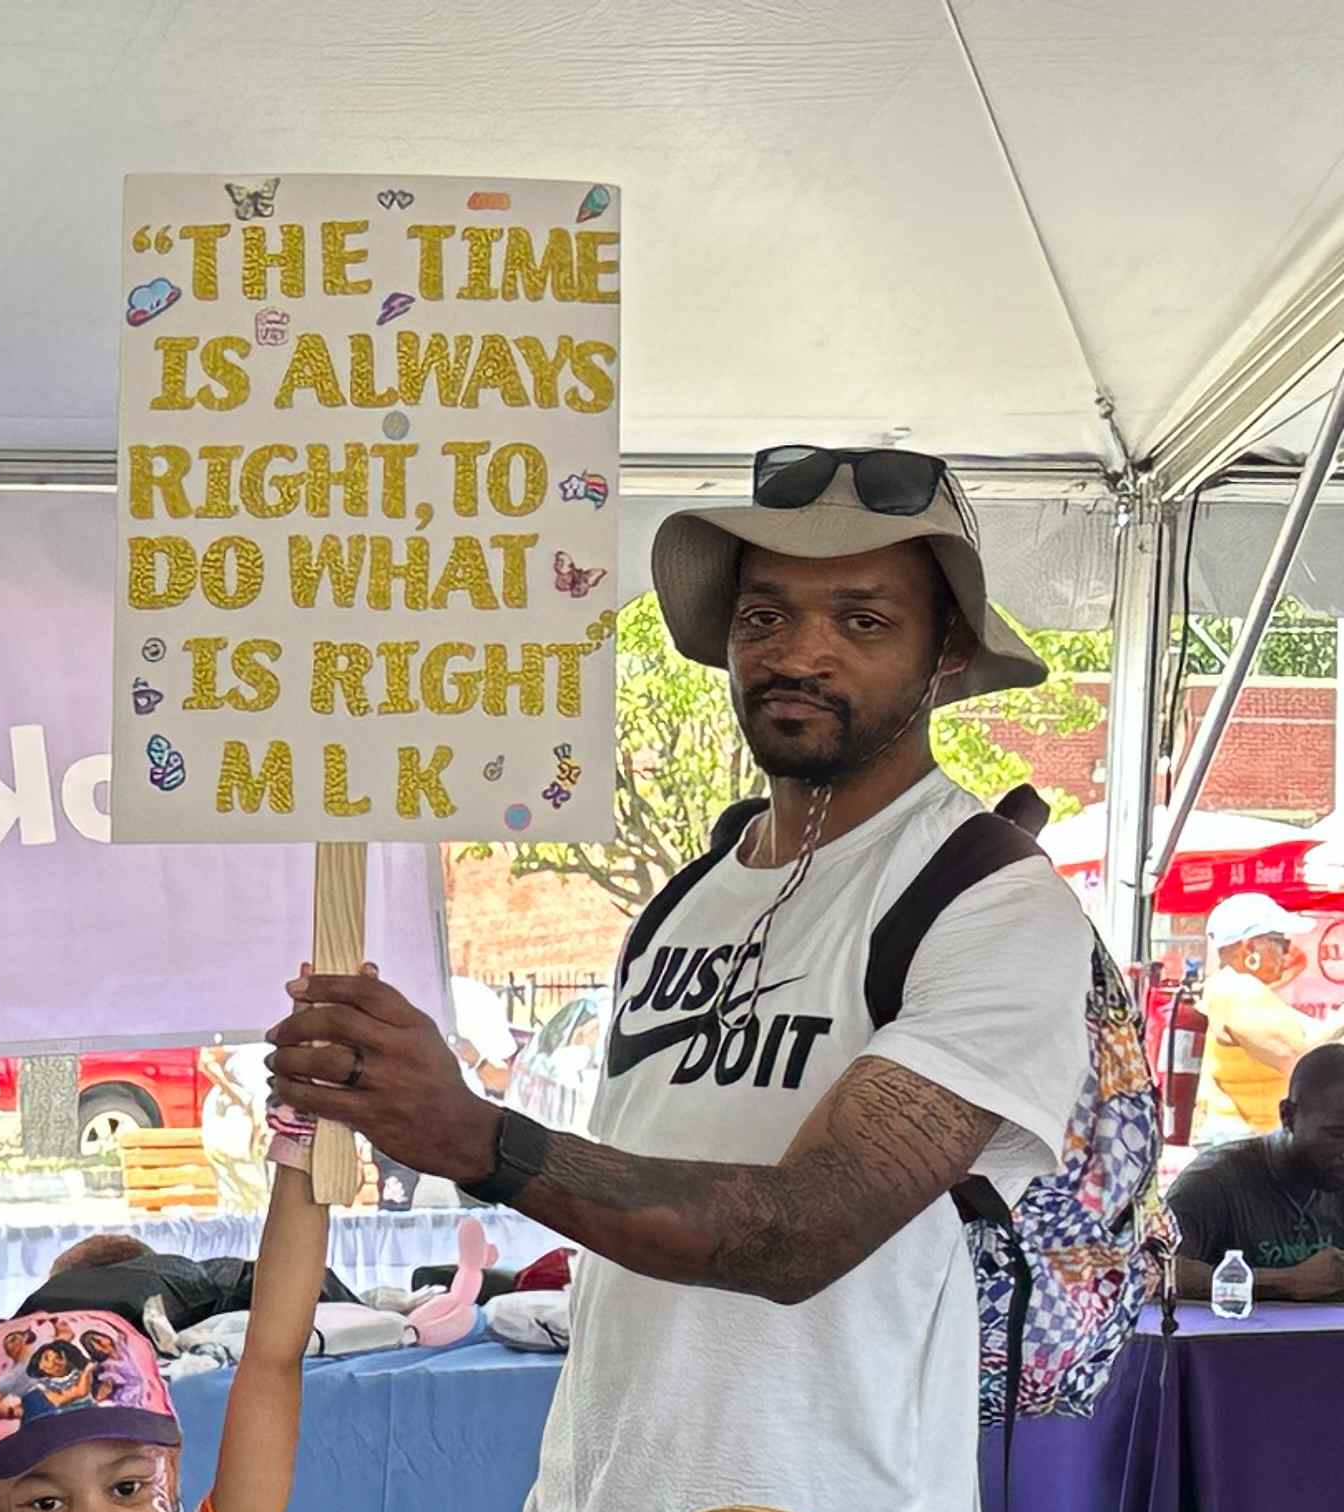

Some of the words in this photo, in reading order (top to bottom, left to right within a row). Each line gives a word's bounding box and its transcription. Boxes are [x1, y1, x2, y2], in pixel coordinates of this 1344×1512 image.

[406, 223, 621, 305] TIME
[150, 335, 253, 412] IS
[274, 331, 618, 413] ALWAYS
[127, 441, 435, 532] RIGHT,
[441, 440, 549, 517] TO
[126, 534, 265, 611] DO
[288, 533, 540, 611] WHAT
[182, 636, 283, 712] IS
[629, 942, 761, 1012] JUST
